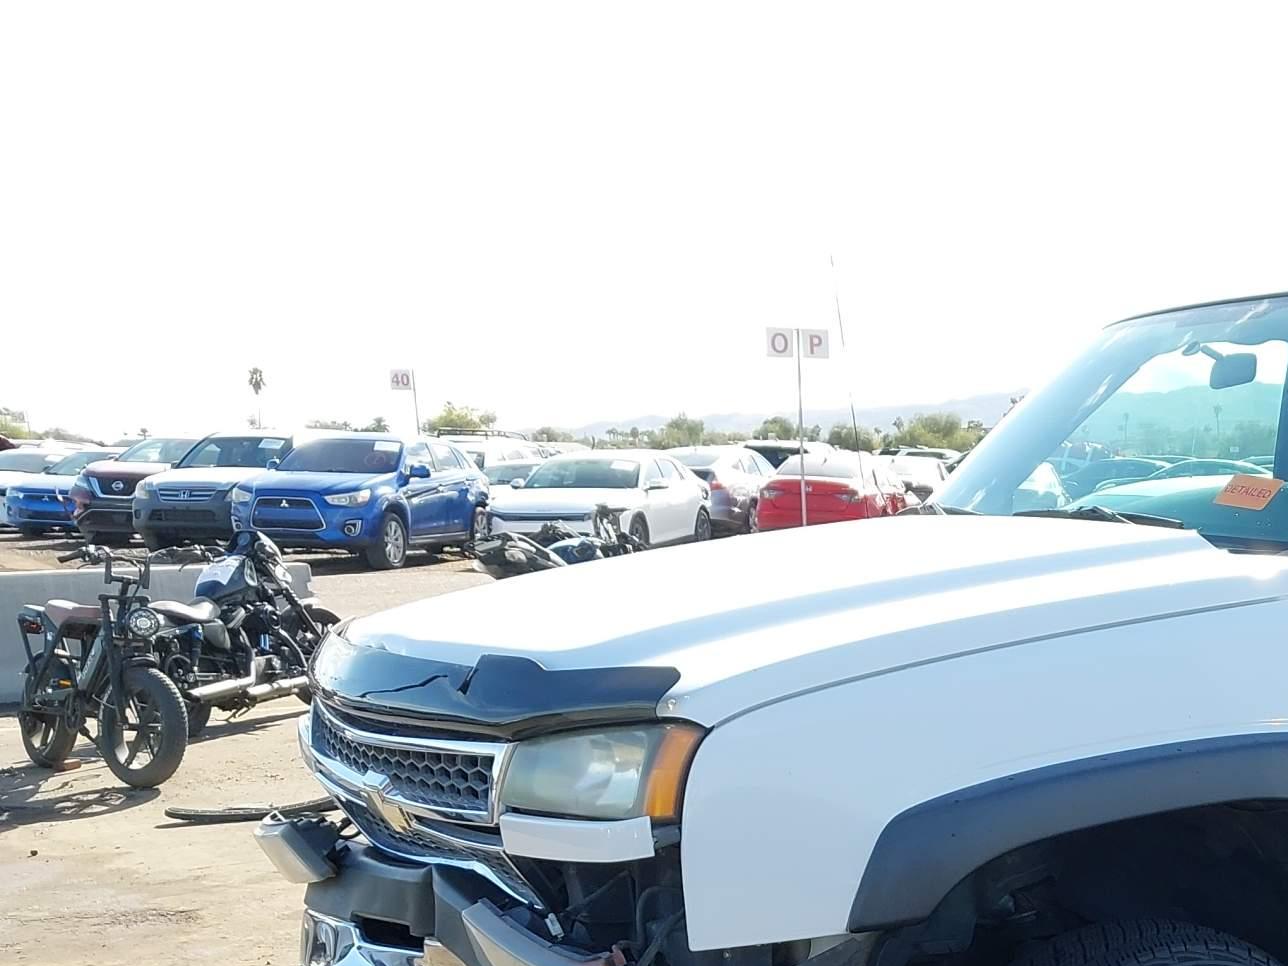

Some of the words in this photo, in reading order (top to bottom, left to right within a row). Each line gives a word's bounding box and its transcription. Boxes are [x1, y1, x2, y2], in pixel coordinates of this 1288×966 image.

[770, 332, 789, 354] O
[808, 334, 823, 355] P
[391, 373, 410, 387] 40
